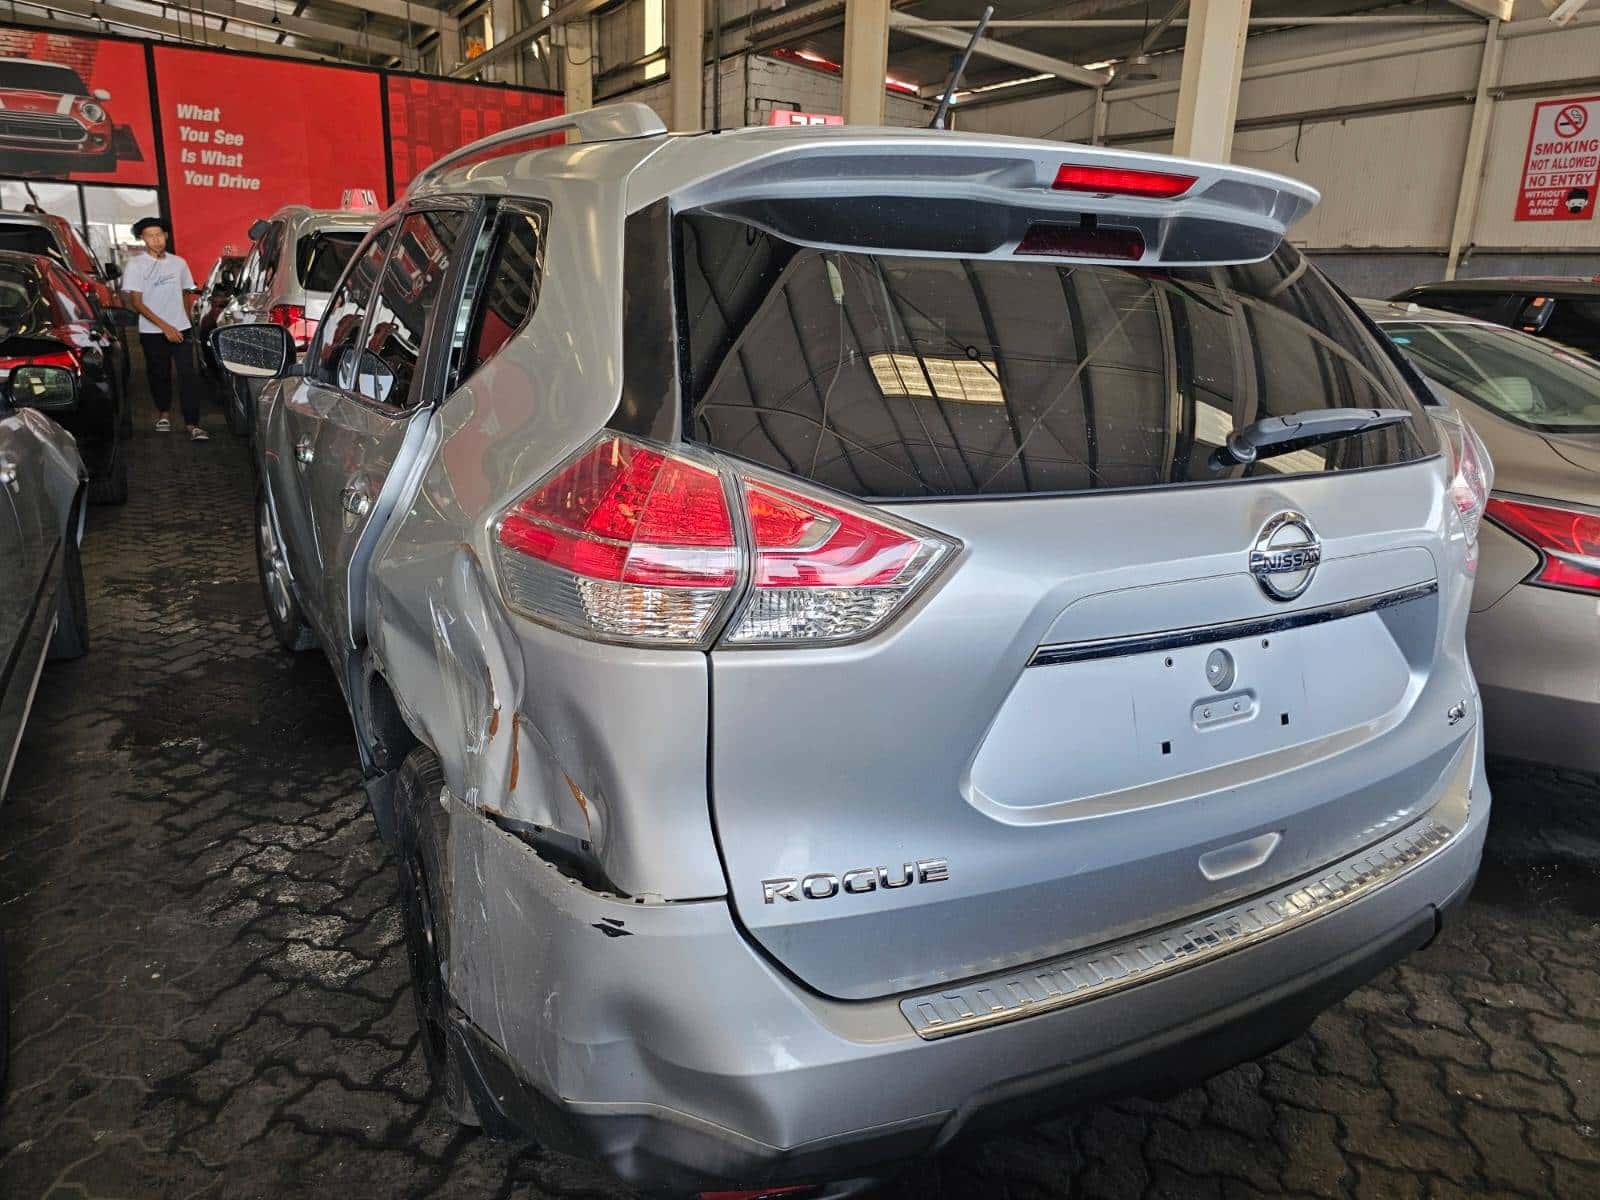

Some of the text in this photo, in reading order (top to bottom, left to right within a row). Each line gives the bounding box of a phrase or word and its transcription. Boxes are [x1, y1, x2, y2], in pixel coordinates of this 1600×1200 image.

[177, 103, 221, 122] What
[179, 126, 244, 146] You See
[1535, 140, 1598, 155] SMOKING
[181, 148, 243, 168] Is What
[1530, 156, 1597, 170] NOT ALLOWED
[184, 170, 260, 190] You Drive
[1529, 173, 1593, 187] NO ENTRY
[1525, 189, 1567, 198] WITHOUT
[1537, 198, 1559, 207] FACE
[1529, 207, 1555, 216] MASK
[1263, 548, 1320, 569] NISSAN
[761, 856, 950, 904] ROGUE
